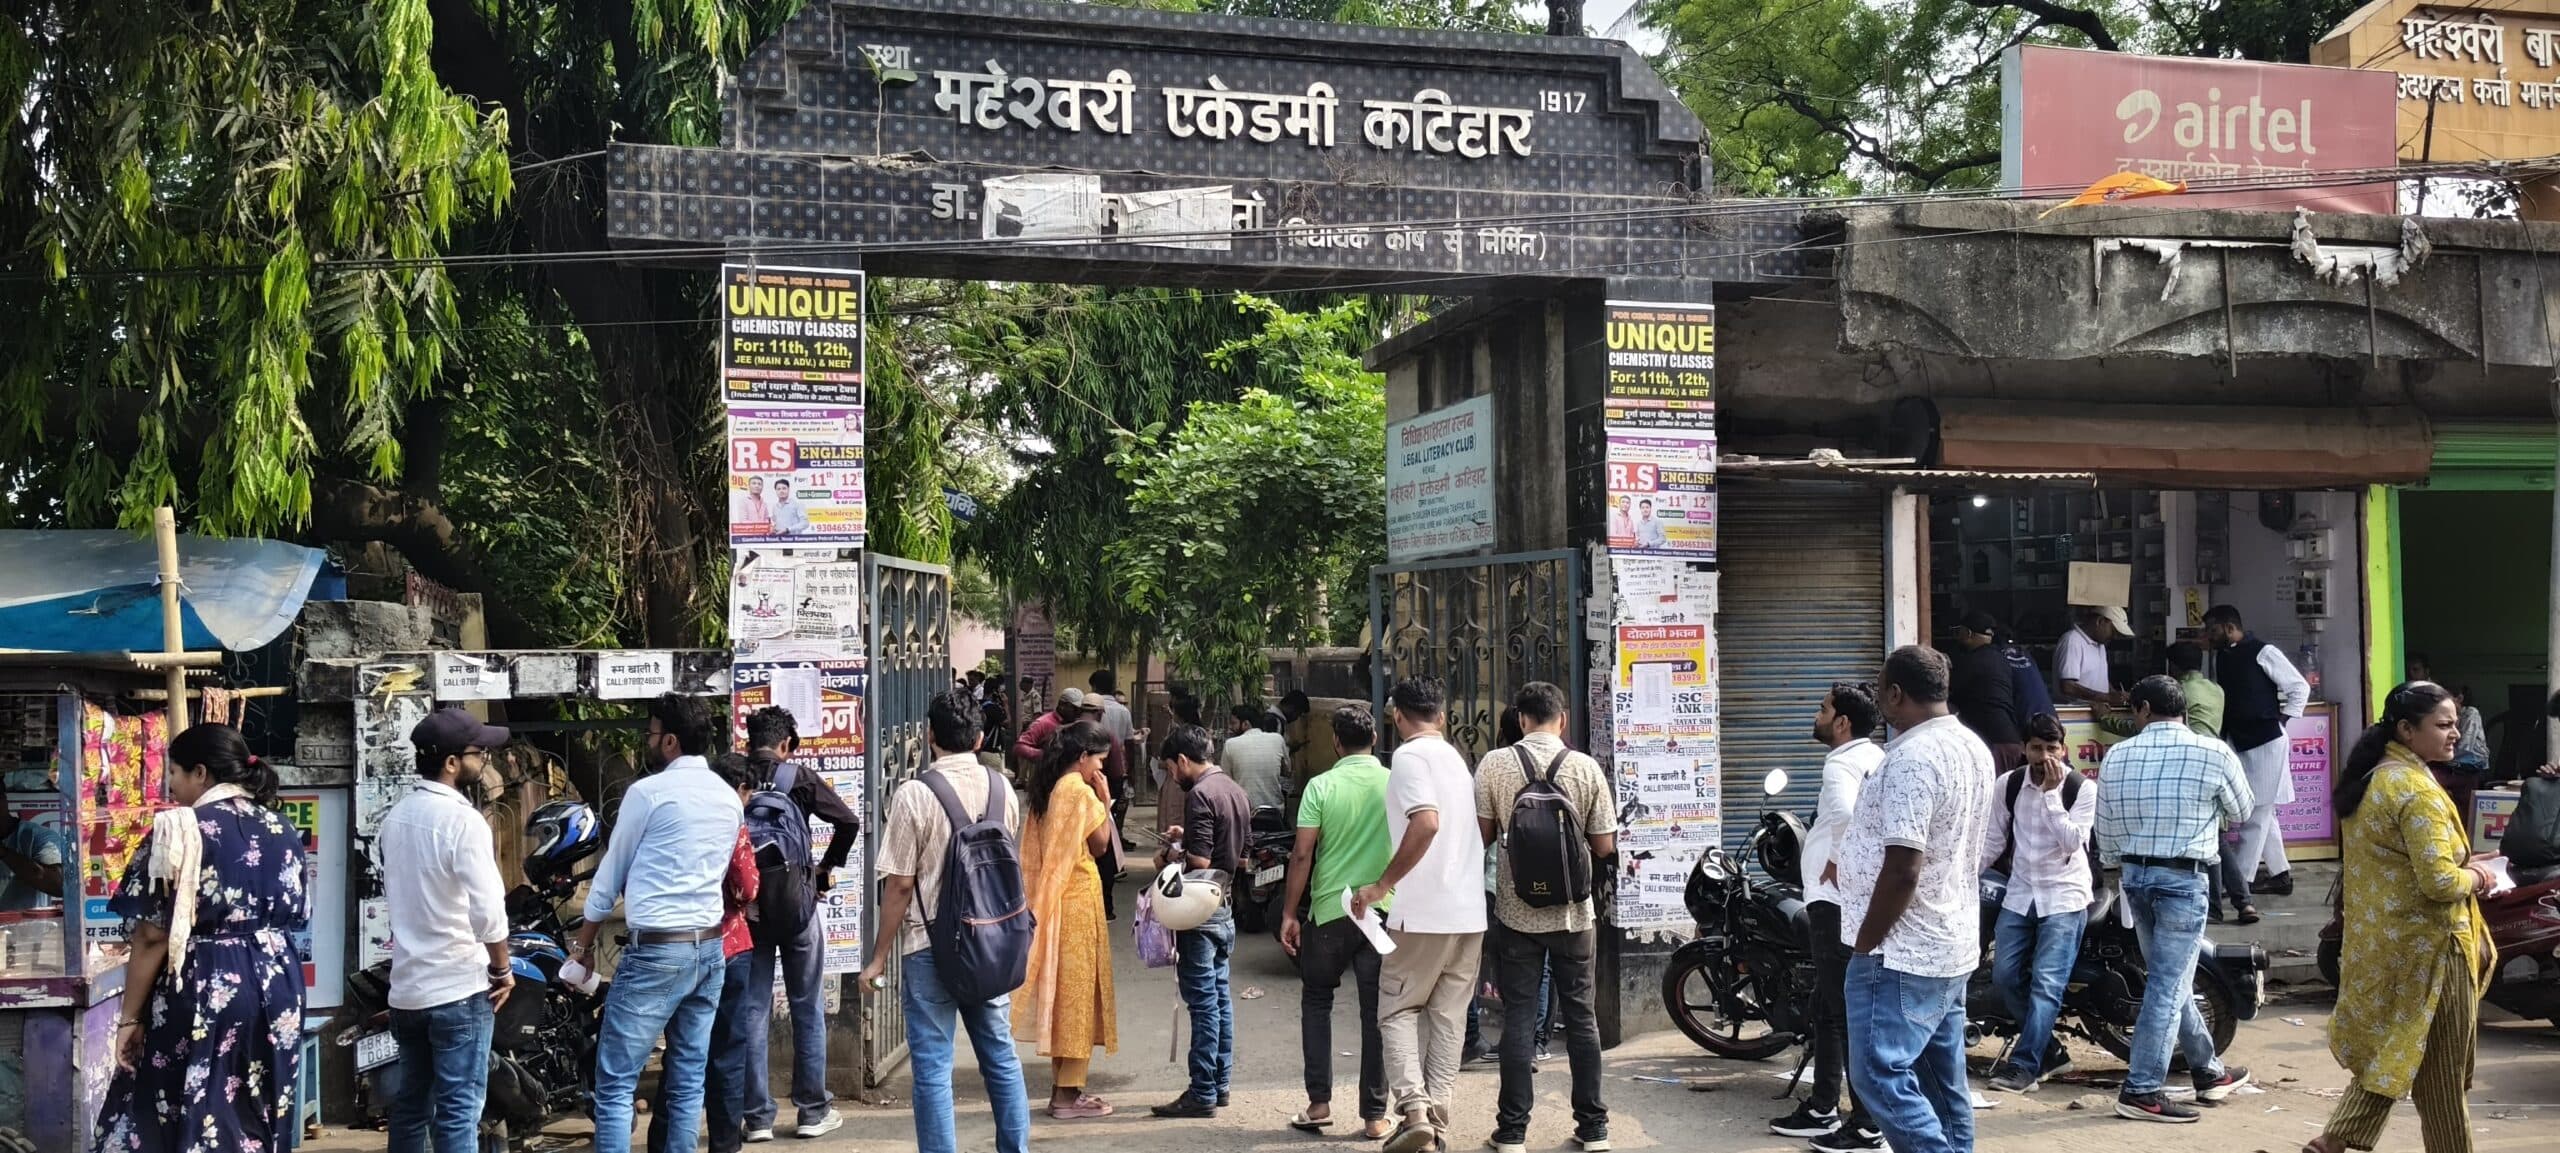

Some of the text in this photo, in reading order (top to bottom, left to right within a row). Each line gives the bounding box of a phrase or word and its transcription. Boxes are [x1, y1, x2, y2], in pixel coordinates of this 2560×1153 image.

[2525, 28, 2560, 67] बा
[1539, 90, 1587, 113] 1917
[1162, 75, 1338, 148] एकेडमी
[1363, 89, 1534, 159] कटिहार
[2174, 87, 2316, 155] airtel
[729, 285, 857, 320] UNIQUE
[732, 319, 857, 338] CHEMISTRY CLASSES
[1607, 322, 1714, 353] UNIQUE
[734, 338, 853, 359] For: 11th, 12th,
[735, 355, 752, 364] JEE
[754, 356, 781, 366] (MAIN
[828, 359, 852, 368] NEET
[1608, 351, 1714, 369] CHEMISTRY CLASSES
[1610, 369, 1710, 388] For: 11th, 12th,
[1611, 385, 1625, 394] JEE
[1627, 386, 1650, 396] (MAIN
[1689, 388, 1710, 397] NEET
[734, 440, 793, 470] R.S
[800, 446, 863, 460] ENGLISH
[1400, 431, 1477, 469] (LEGAL LITERACY CLUB)
[1609, 463, 1654, 490] R.S
[1660, 471, 1714, 484] ENGLISH
[464, 665, 480, 674] खा
[627, 662, 651, 674] खाली
[653, 661, 660, 674] है
[820, 660, 865, 669] INDIA'S
[1672, 703, 1702, 714] ANK
[818, 747, 856, 756] KATIHAR
[2077, 738, 2103, 763] मो
[2290, 737, 2325, 756] न्टर
[1660, 771, 1679, 780] खाली
[1680, 769, 1687, 780] है
[2290, 761, 2322, 770] ENTRE
[2478, 800, 2498, 810] CSC
[1662, 872, 1682, 883] खाली
